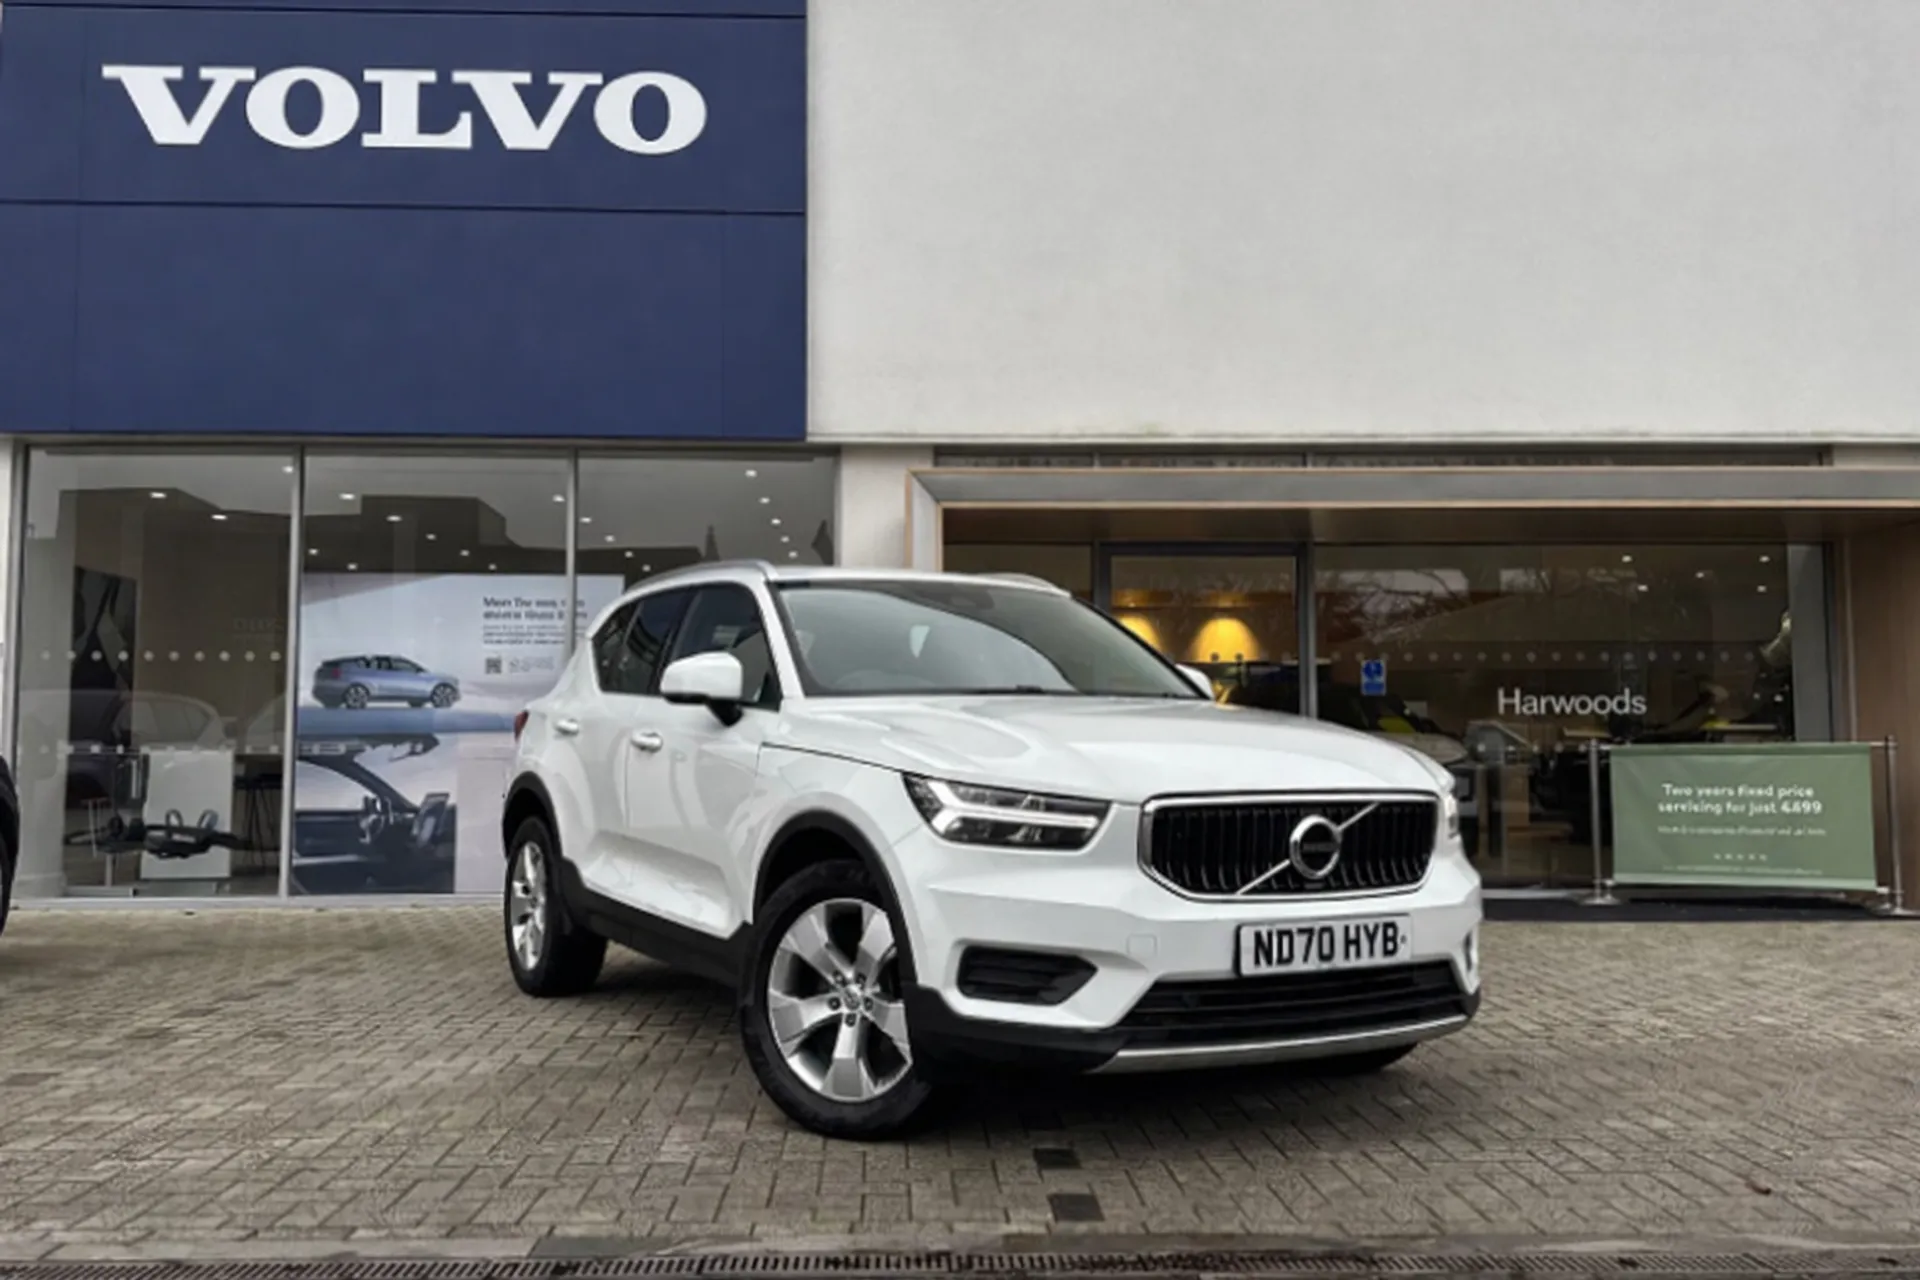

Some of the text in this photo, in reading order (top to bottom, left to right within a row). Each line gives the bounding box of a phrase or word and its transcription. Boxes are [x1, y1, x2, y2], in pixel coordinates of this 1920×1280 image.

[102, 64, 707, 155] VOLVO
[1498, 687, 1648, 715] Harwoods
[1661, 783, 1814, 800] Two years fixed price
[1658, 800, 1723, 815] servicing
[1726, 801, 1746, 813] for
[1748, 802, 1777, 817] just
[1253, 920, 1398, 968] ND70 HYB
